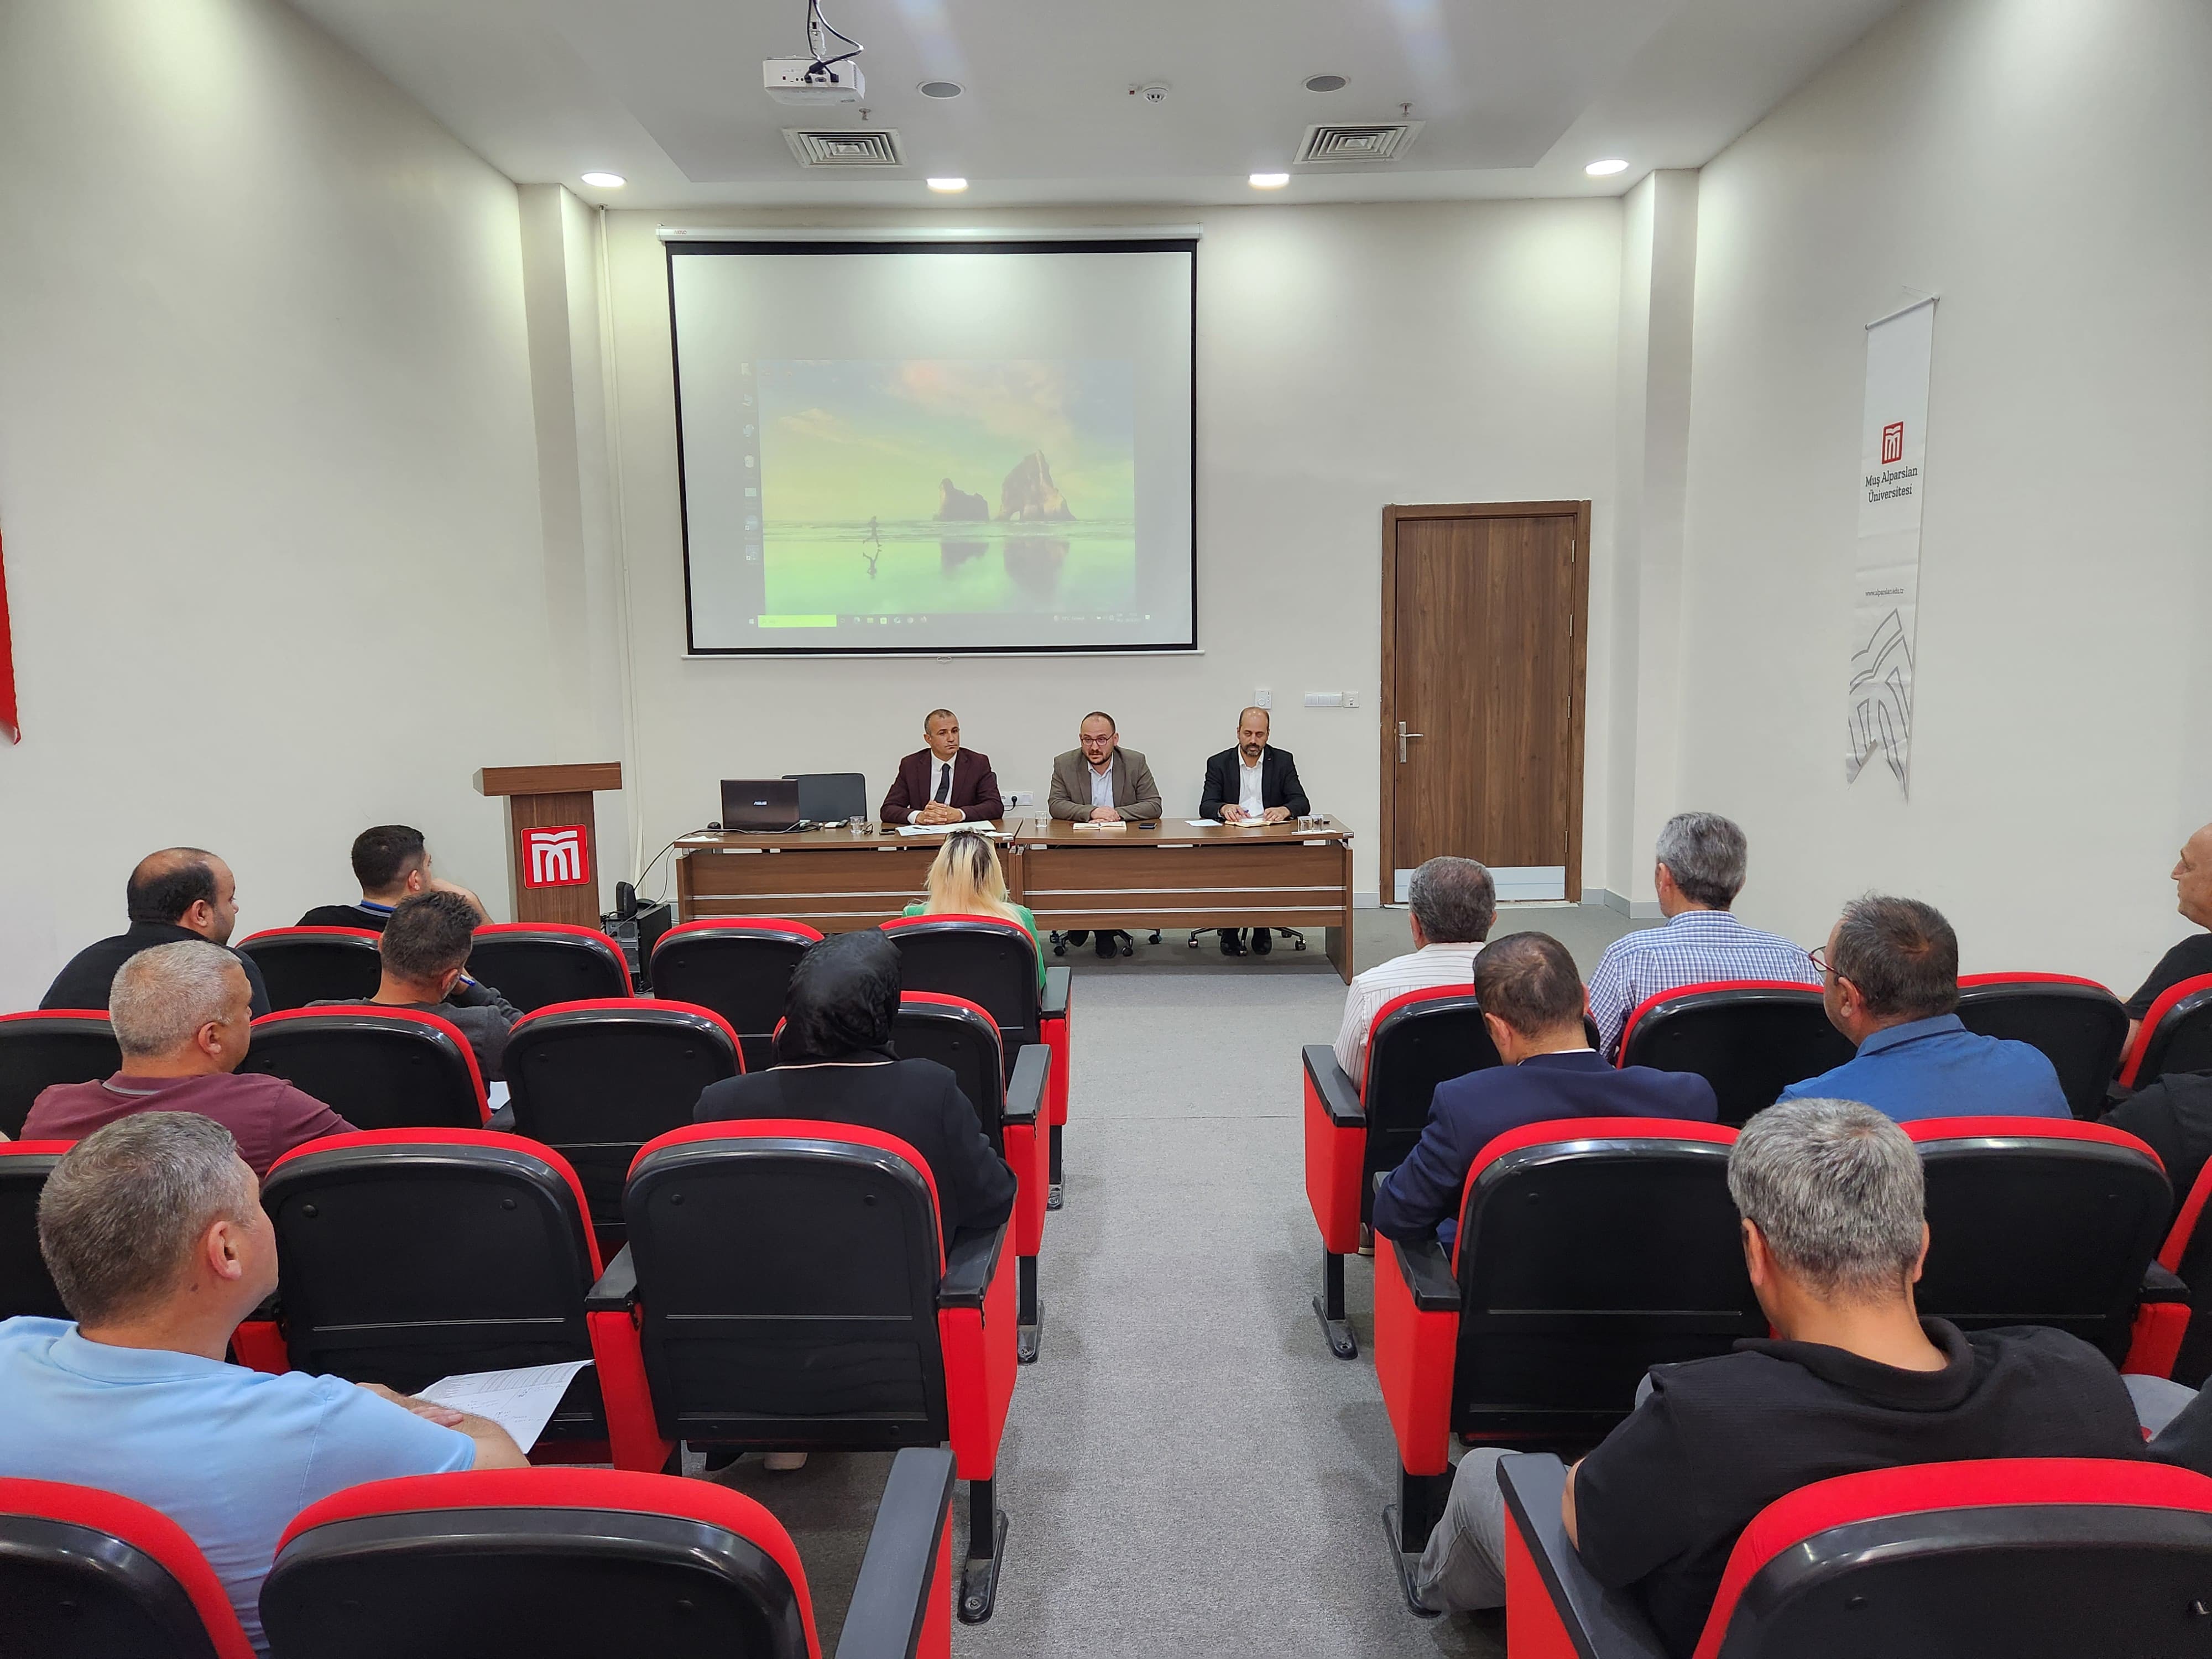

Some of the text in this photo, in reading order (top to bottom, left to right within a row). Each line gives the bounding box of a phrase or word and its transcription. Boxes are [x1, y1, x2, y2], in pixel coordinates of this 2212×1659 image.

[1865, 466, 1918, 487] Muş Alparslan
[1868, 483, 1912, 503] Üniversitesi
